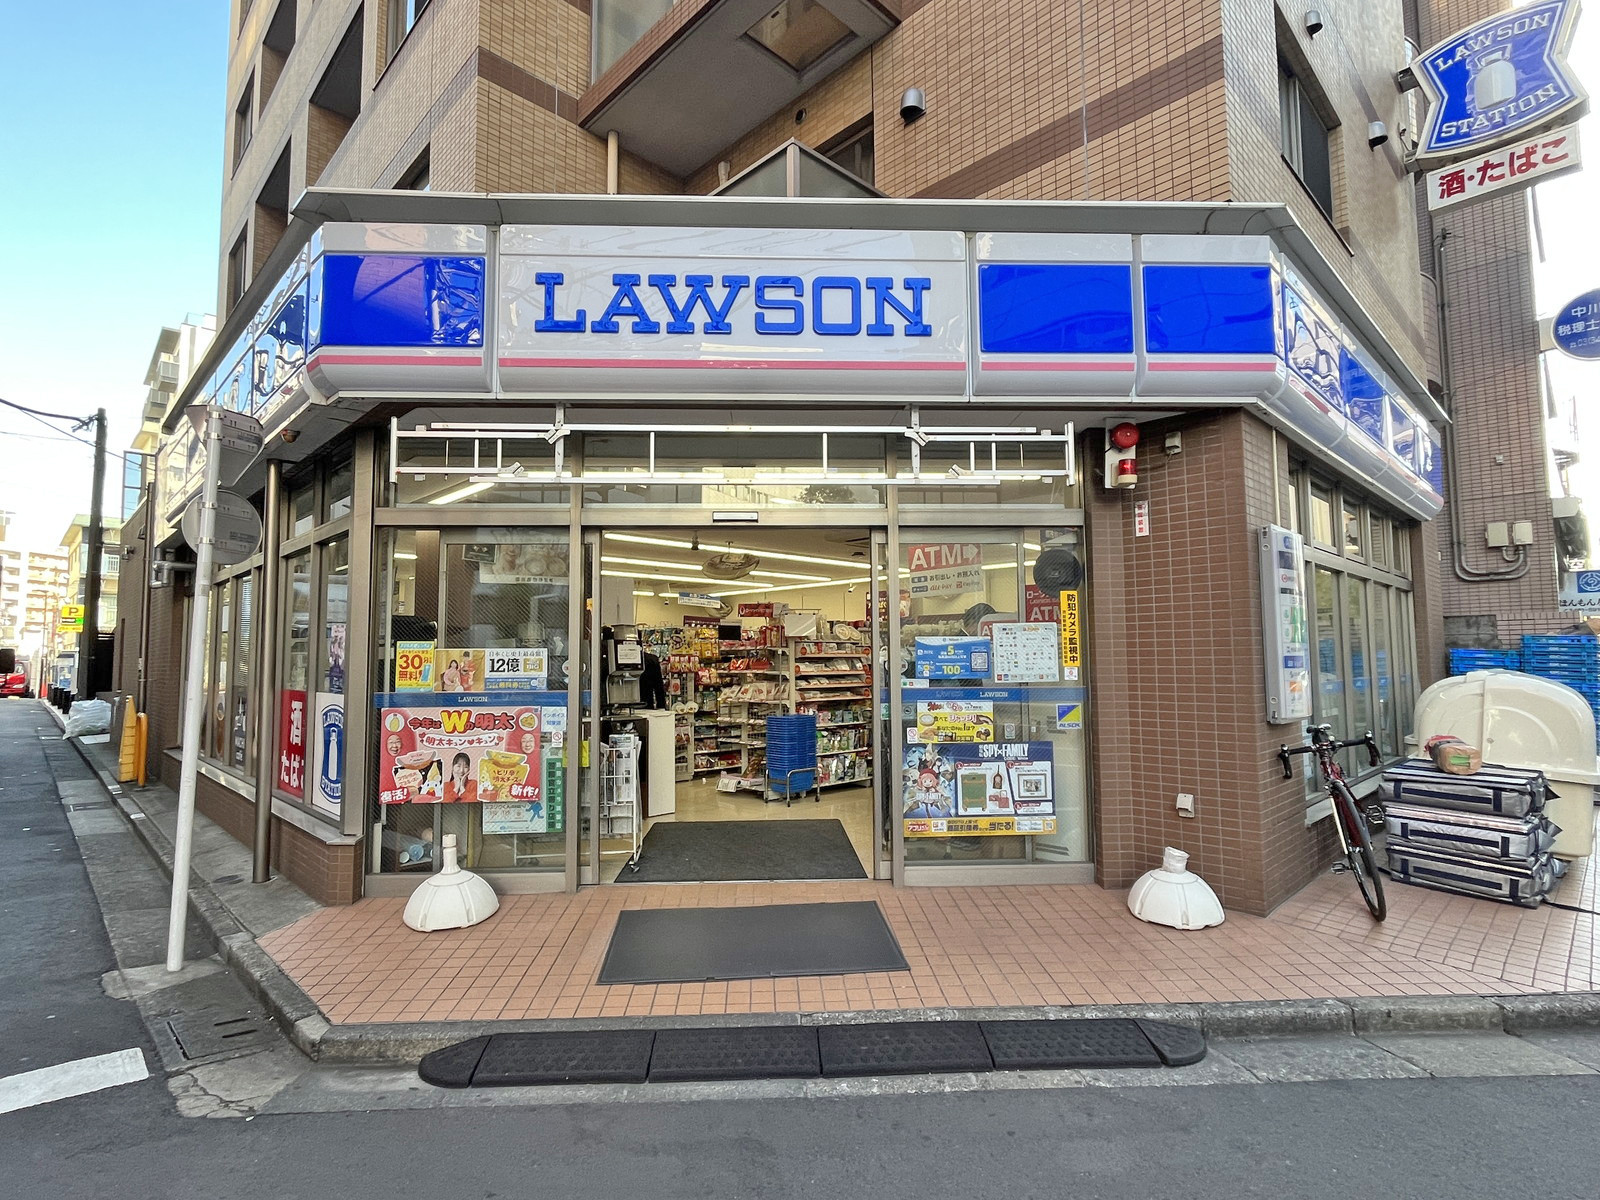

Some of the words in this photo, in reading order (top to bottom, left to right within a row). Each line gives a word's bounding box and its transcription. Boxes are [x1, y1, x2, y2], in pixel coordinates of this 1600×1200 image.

[1434, 12, 1552, 71] LAWSON
[1440, 84, 1558, 137] STATION
[1438, 136, 1569, 199] 酒・たばこ
[534, 272, 932, 336] LAWSON
[1571, 303, 1600, 317] 中川
[1558, 319, 1600, 336] 税理士
[911, 544, 961, 569] ATM
[69, 607, 79, 615] P
[1066, 594, 1078, 663] 防犯カメラ監視中
[489, 658, 520, 672] 12億
[290, 700, 303, 746] 酒
[381, 788, 408, 803] 復活!
[510, 784, 539, 798] 新作!
